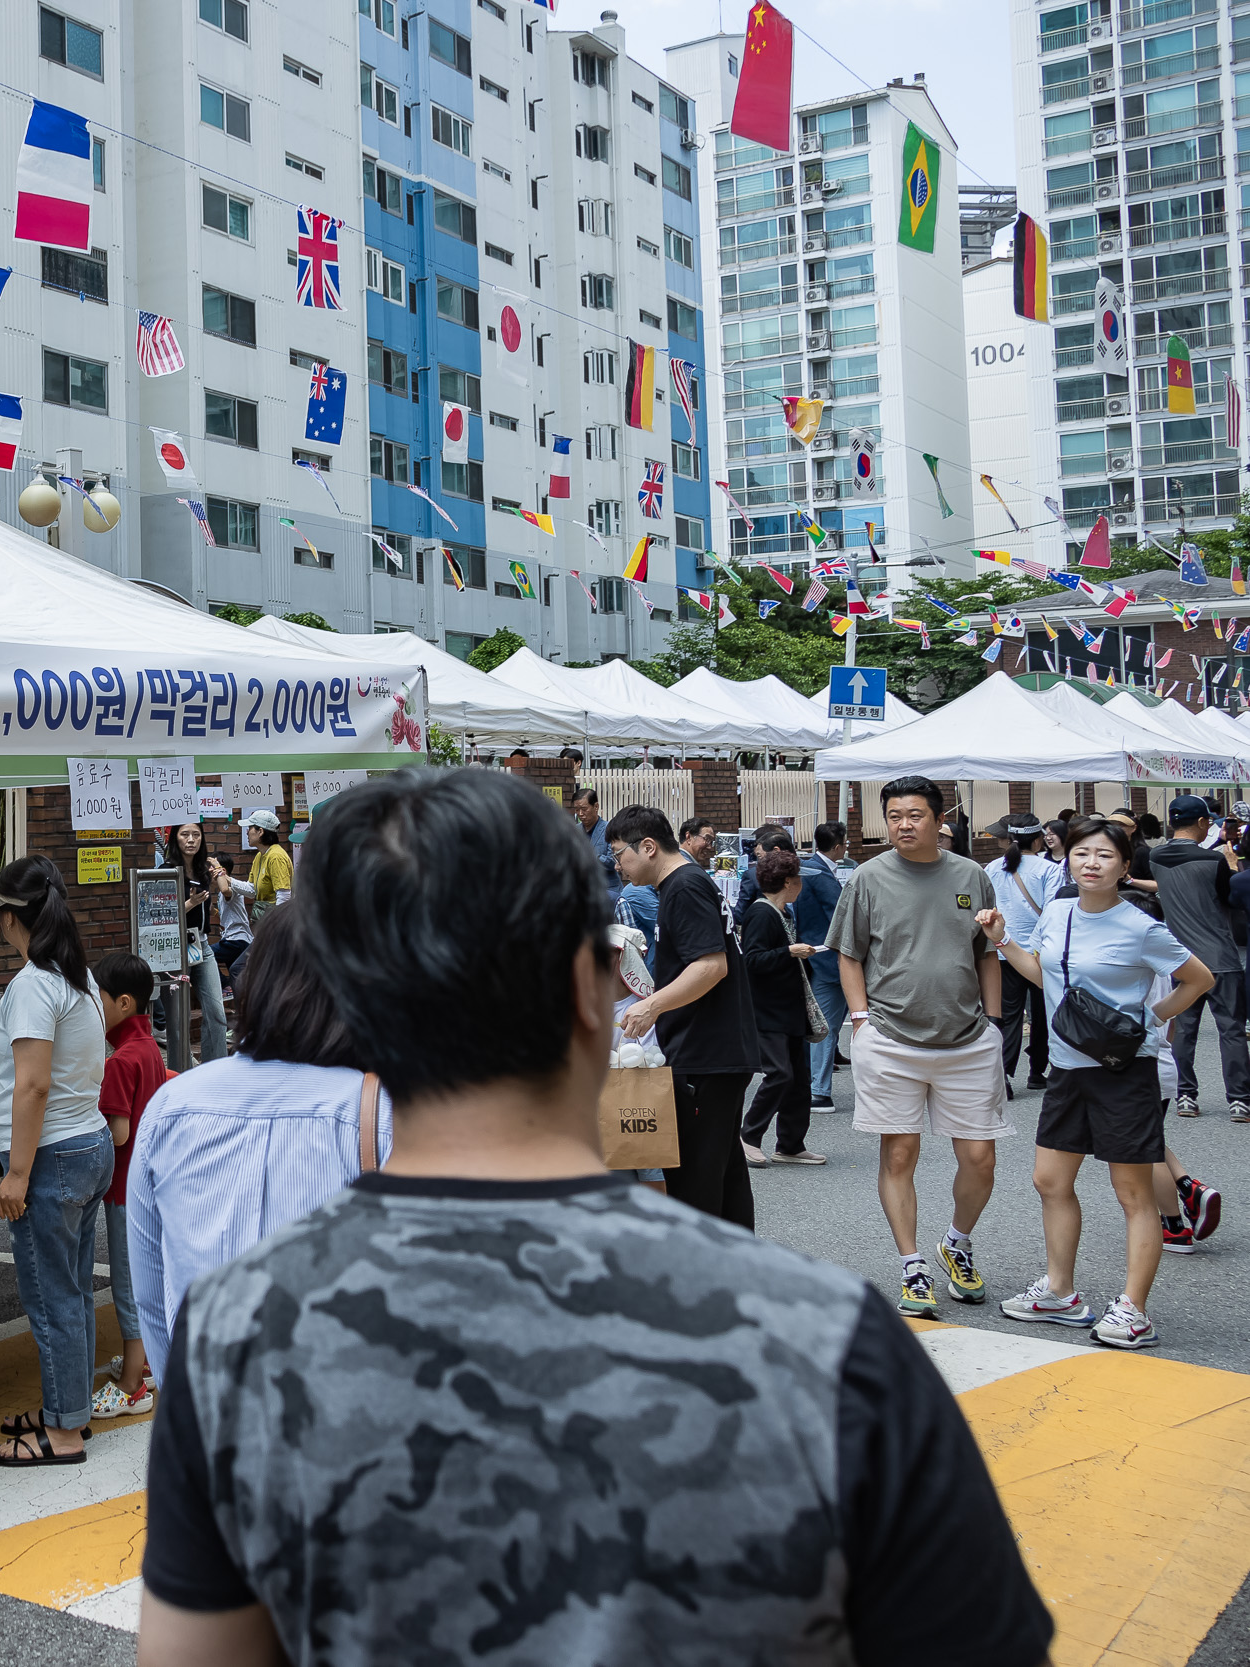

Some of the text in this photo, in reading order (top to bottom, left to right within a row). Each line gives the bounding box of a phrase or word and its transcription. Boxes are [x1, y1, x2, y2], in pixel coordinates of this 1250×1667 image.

[245, 677, 358, 738] 2,000원
[834, 705, 880, 718] 일방통행
[76, 763, 112, 790] 음료수
[144, 766, 184, 792] 막걸리
[618, 1107, 656, 1118] TOPTEN
[620, 1118, 658, 1134] KIDS
